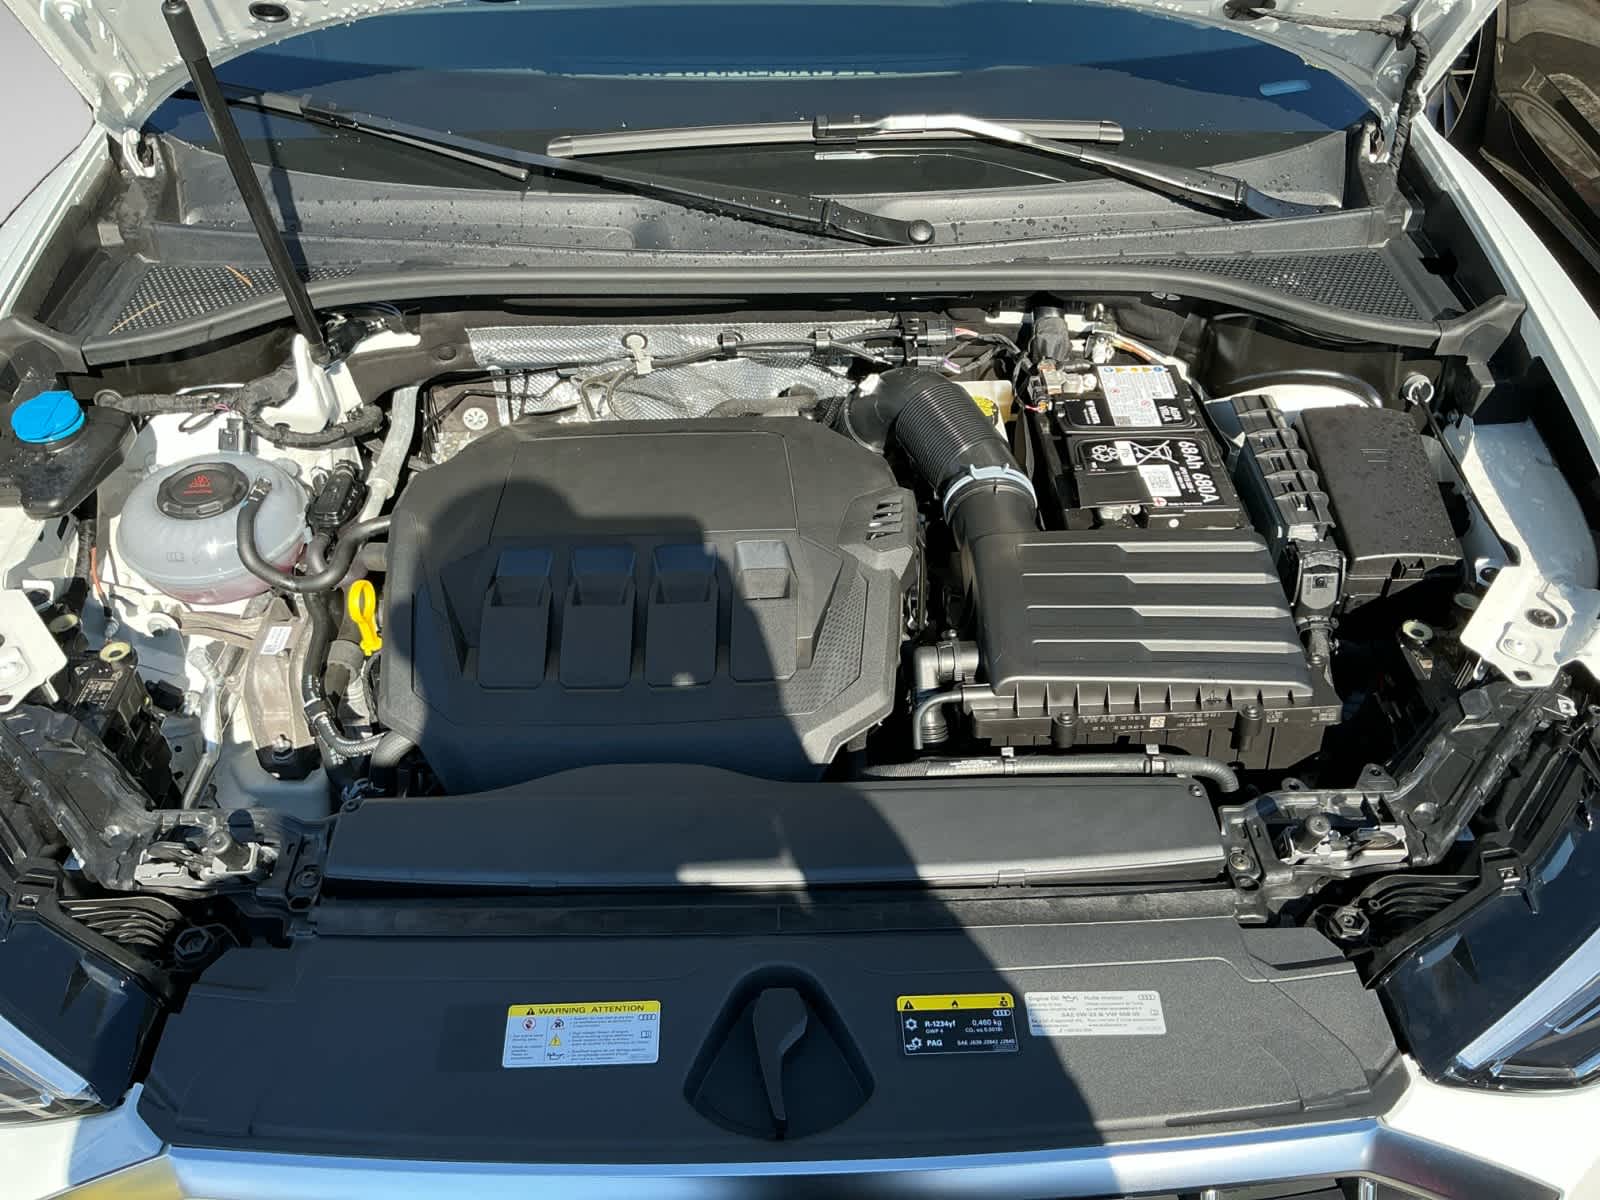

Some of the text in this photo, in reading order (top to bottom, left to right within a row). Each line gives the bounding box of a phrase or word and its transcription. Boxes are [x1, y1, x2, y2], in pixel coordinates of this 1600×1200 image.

[1178, 441, 1205, 470] 68Ah
[1192, 473, 1220, 503] 680A
[539, 1004, 645, 1015] WARNING ATTENTION
[924, 1019, 956, 1029] R-1234yf
[926, 1039, 943, 1047] PAG
